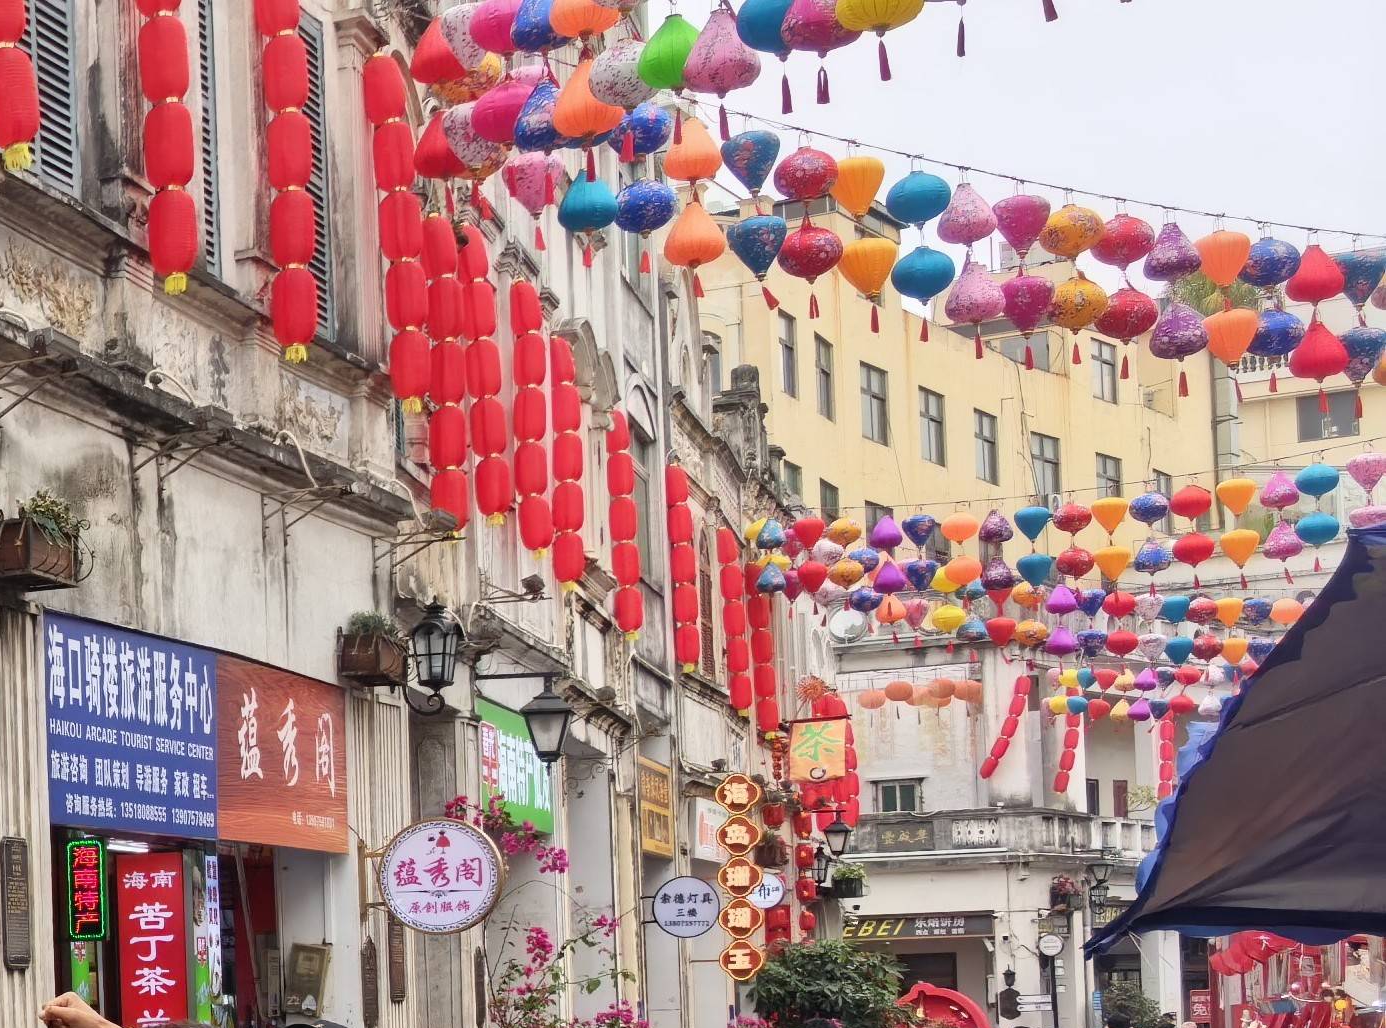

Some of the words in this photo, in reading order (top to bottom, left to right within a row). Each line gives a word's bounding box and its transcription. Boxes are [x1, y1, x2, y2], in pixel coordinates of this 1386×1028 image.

[48, 624, 213, 734] 海口骑楼旅游服务中心
[50, 719, 82, 739] HAIKOU
[86, 727, 117, 745] ARCADE
[120, 732, 152, 750] TOURIST
[155, 739, 185, 756] SERVICE
[187, 743, 214, 761] CENTER
[792, 724, 841, 762] 茶
[51, 750, 88, 784] 旅游咨询
[95, 758, 130, 790] 团队策划
[135, 764, 168, 795] 导游服务
[123, 870, 176, 889] 海南
